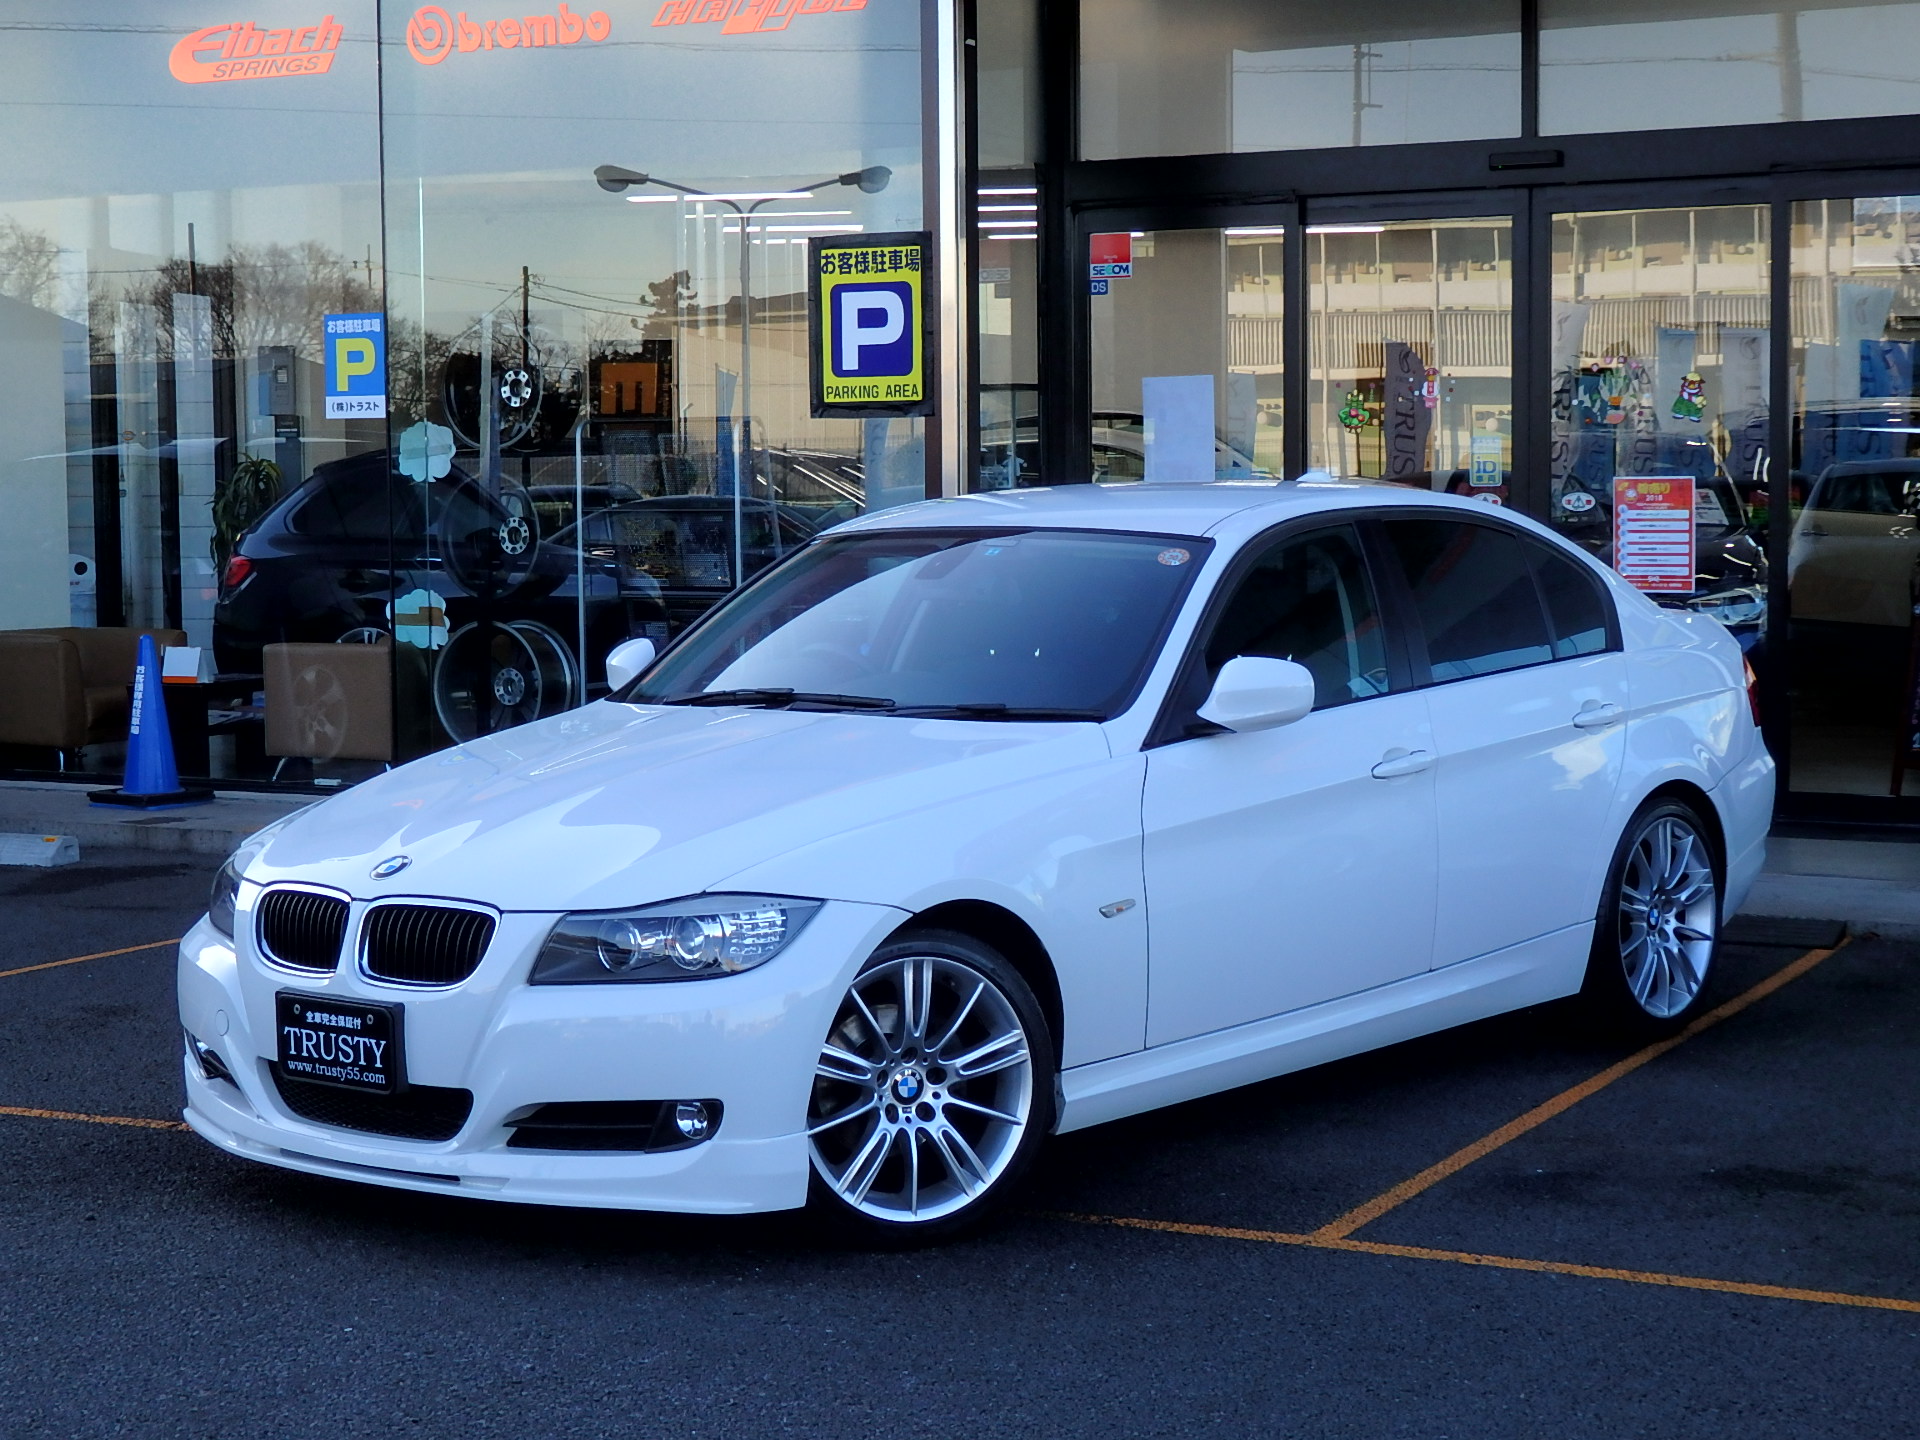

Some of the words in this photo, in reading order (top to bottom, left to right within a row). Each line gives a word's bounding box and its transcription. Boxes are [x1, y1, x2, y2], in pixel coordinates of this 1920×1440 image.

[457, 3, 611, 53] brembo
[168, 14, 344, 84] Eibach
[213, 55, 321, 79] SPRINGS
[820, 248, 921, 276] お客様駐車場
[1092, 264, 1130, 276] SECOM
[1091, 282, 1106, 293] DS
[327, 318, 381, 334] お客様駐車場
[841, 290, 905, 371] P
[335, 338, 375, 391] P
[826, 384, 879, 400] PARKING
[885, 384, 919, 398] AREA
[331, 401, 380, 413] (株)トラスト
[305, 1010, 362, 1030] 全車完全保証付
[283, 1026, 387, 1068] TRUSTY
[287, 1060, 386, 1084] www.trusty55.com
